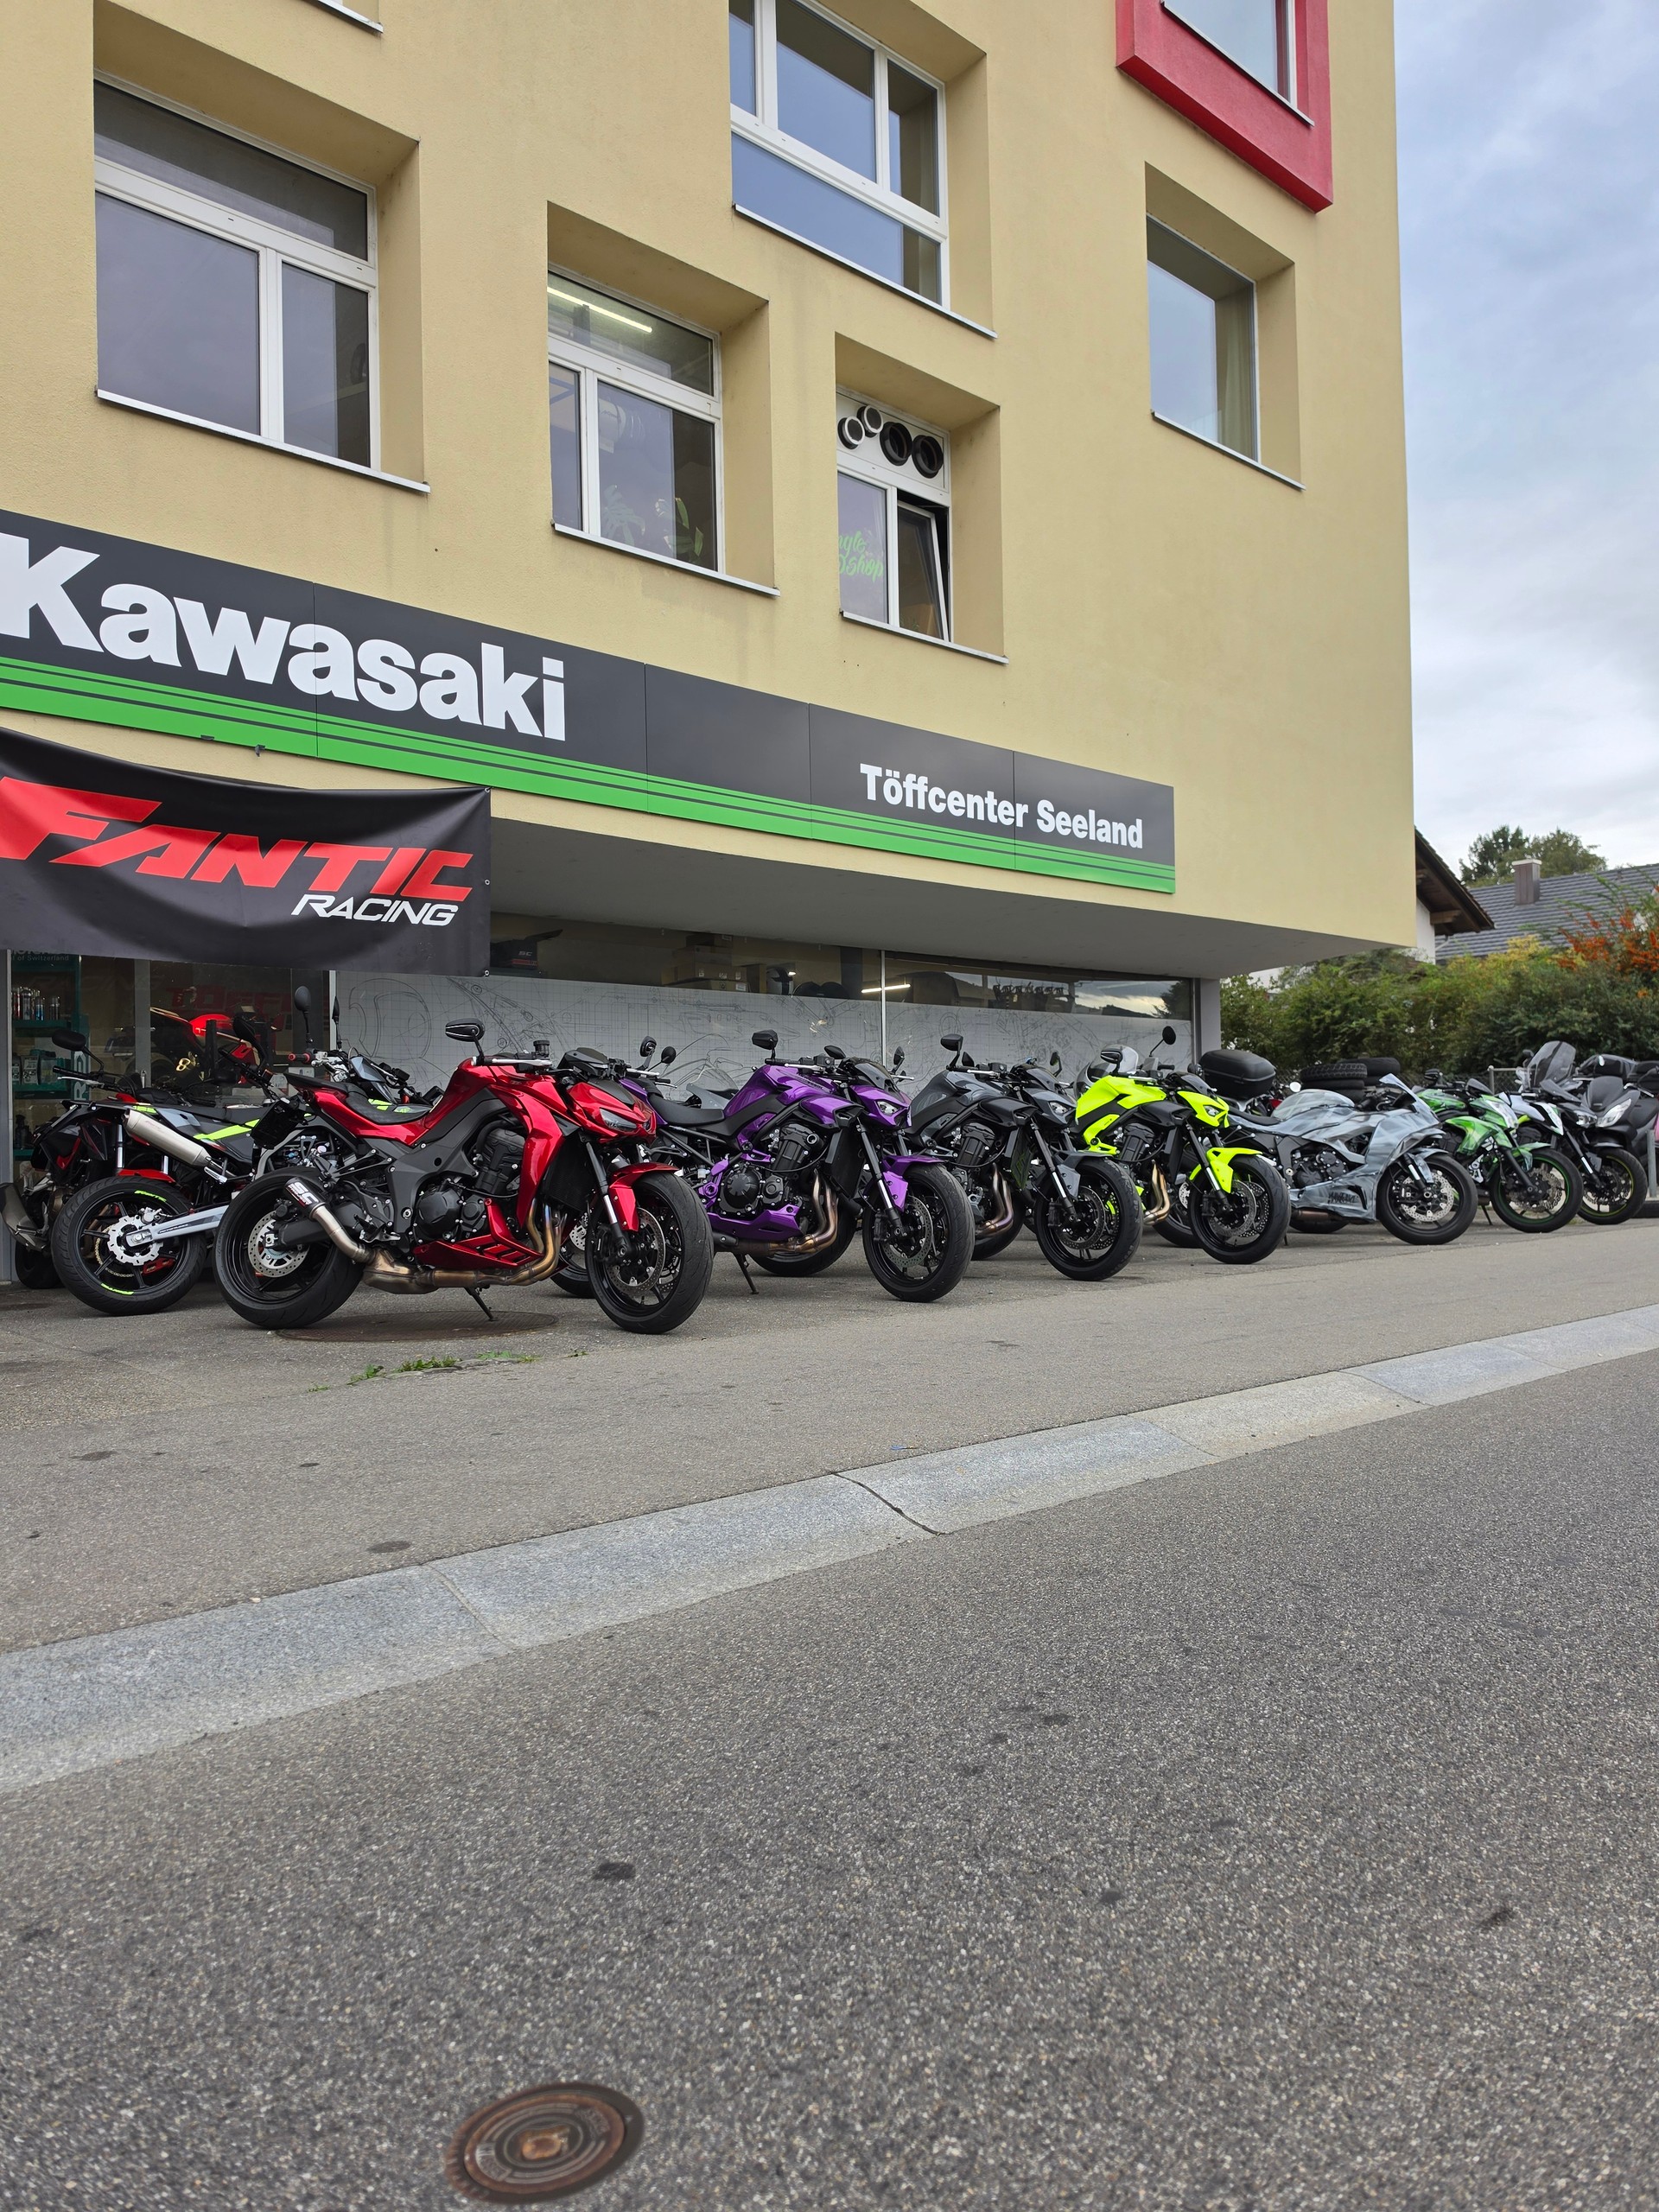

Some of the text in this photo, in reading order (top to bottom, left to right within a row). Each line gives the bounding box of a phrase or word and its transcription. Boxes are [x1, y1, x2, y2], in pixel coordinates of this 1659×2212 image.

[0, 532, 566, 741] Kawasaki
[0, 776, 474, 902] FANTIC
[860, 762, 1142, 849] Töffcenter Seeland
[291, 893, 459, 927] RACING
